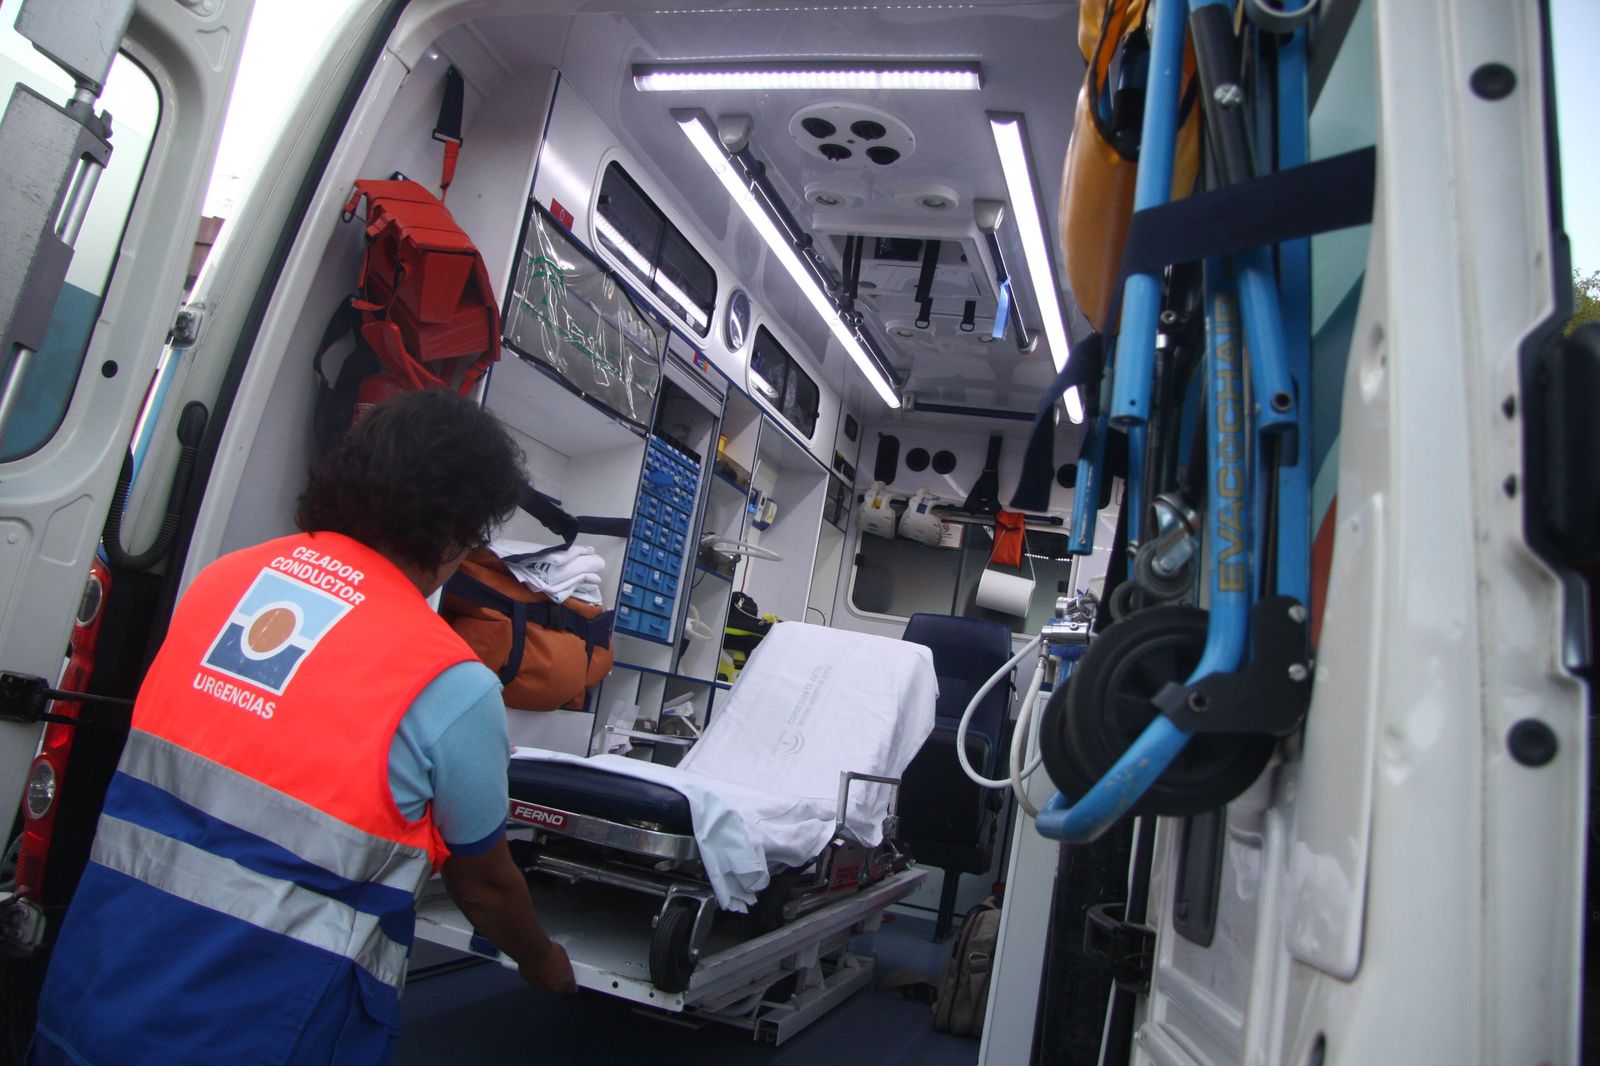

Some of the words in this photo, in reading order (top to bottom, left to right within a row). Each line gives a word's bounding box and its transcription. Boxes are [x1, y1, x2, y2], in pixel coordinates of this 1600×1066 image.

[270, 556, 366, 606] CONDUCTOR
[291, 545, 365, 587] CELADOR
[192, 671, 276, 720] URGENCIAS
[514, 805, 564, 826] FERNO
